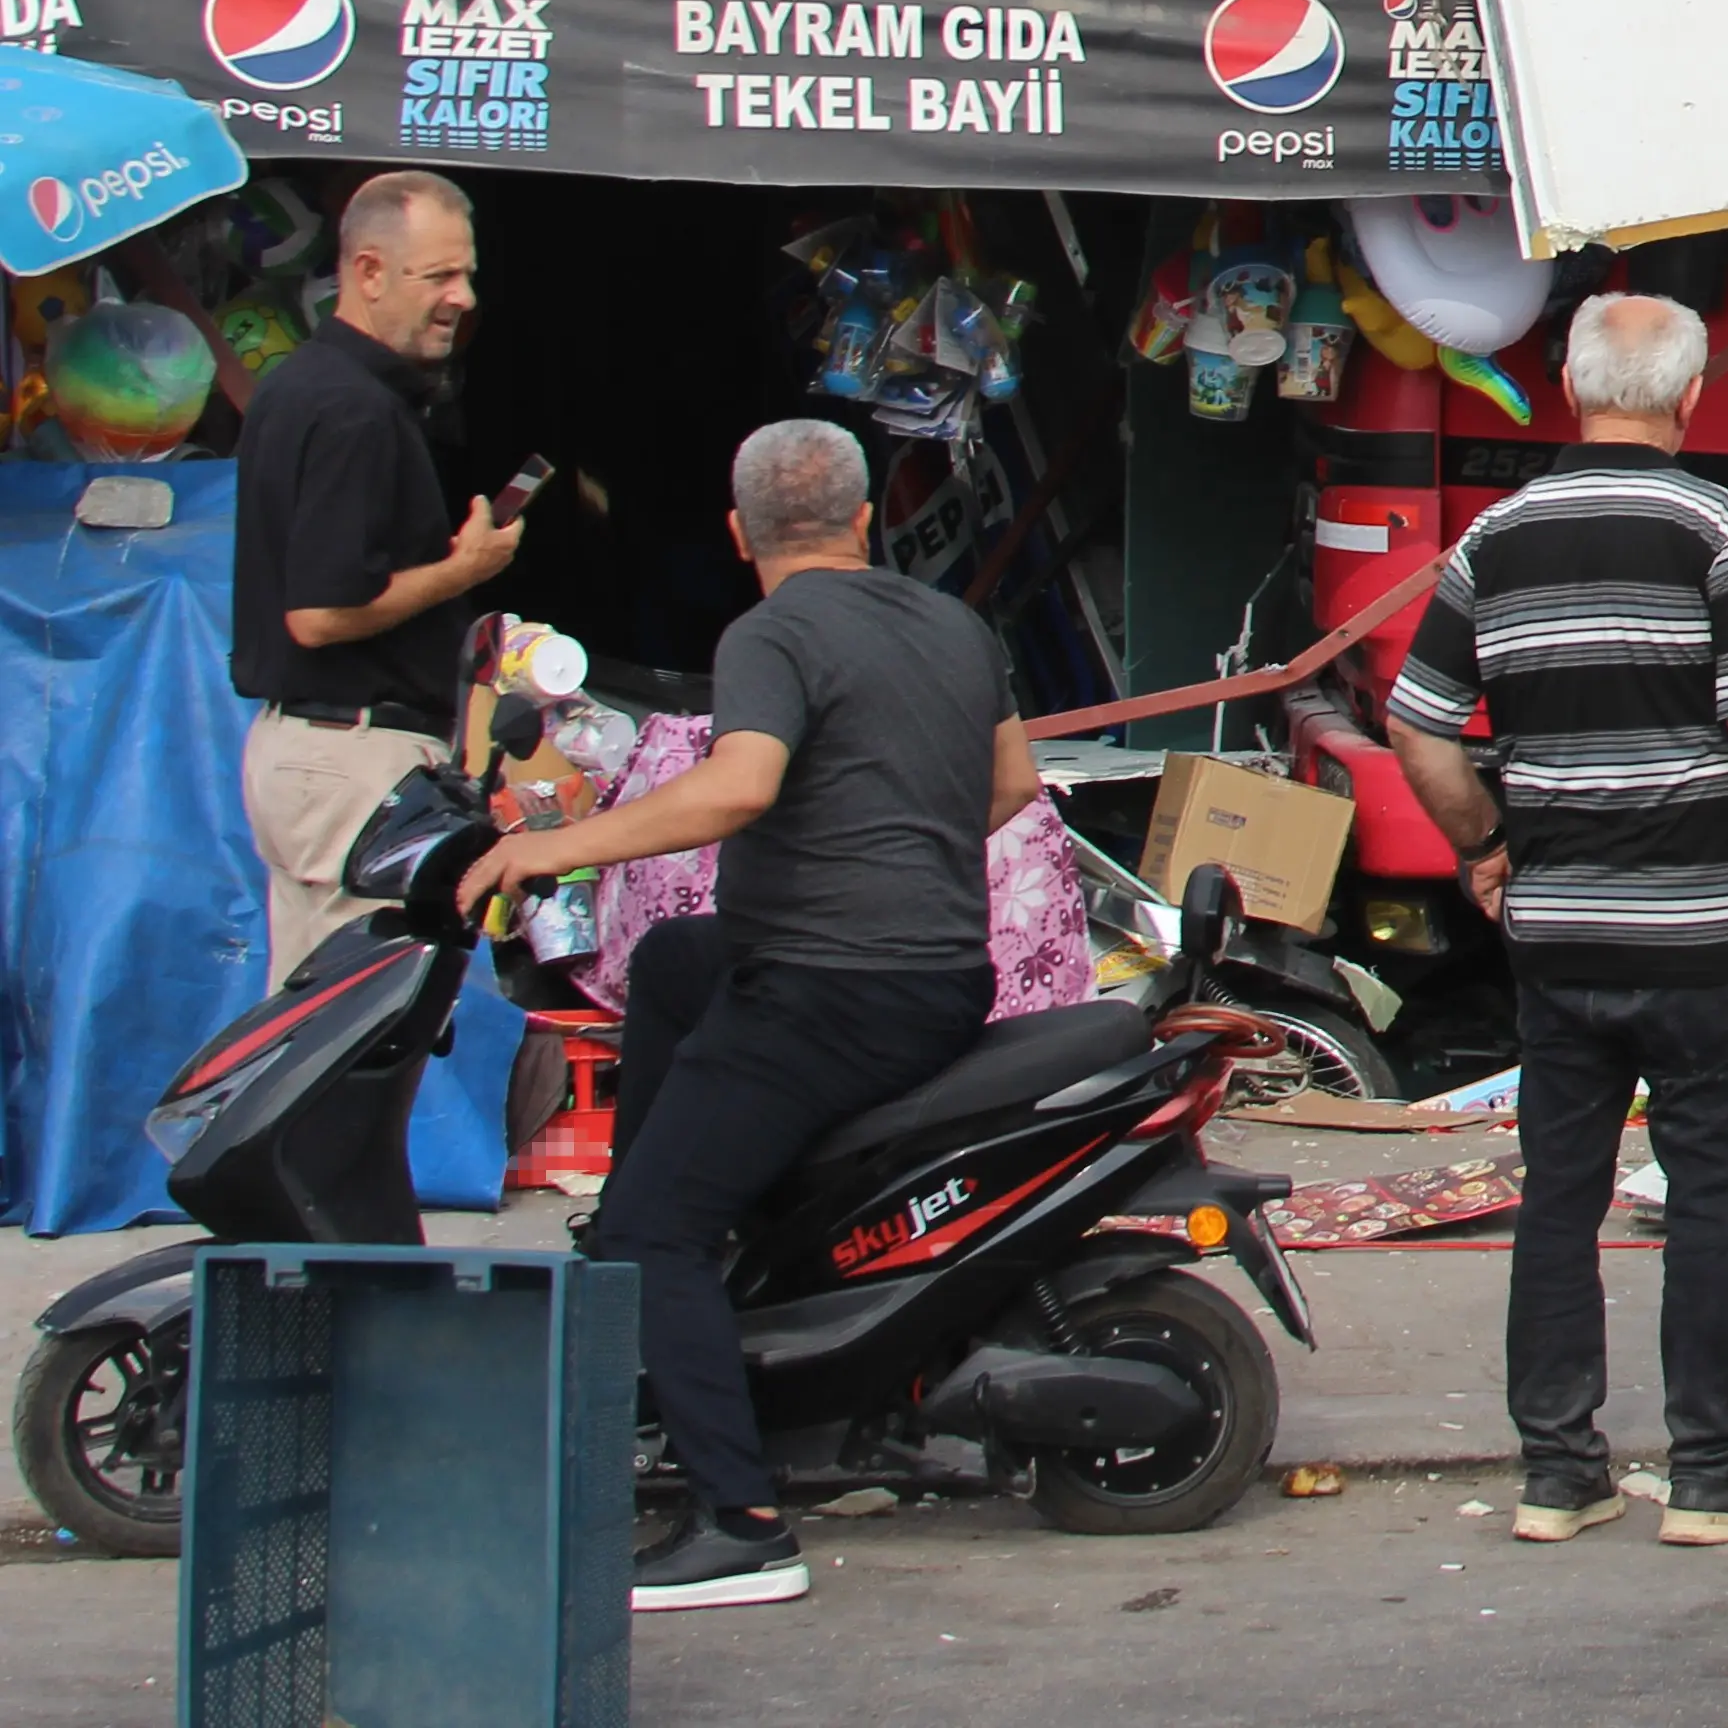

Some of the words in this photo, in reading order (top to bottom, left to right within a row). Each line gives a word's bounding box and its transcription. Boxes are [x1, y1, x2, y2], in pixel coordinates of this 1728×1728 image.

[401, 26, 554, 60] LEZZET
[674, 0, 924, 61] BAYRAM
[942, 5, 1086, 63] GIDA
[403, 58, 549, 99] SIFIR
[1389, 49, 1491, 80] LEZZ
[222, 96, 344, 133] pepsi
[696, 74, 891, 131] TEKEL
[1391, 80, 1499, 118] SIFI
[307, 131, 343, 145] max
[1217, 126, 1335, 163] pepsi
[80, 141, 182, 217] pepsi
[1303, 157, 1335, 170] max
[833, 1177, 970, 1270] skyjet
